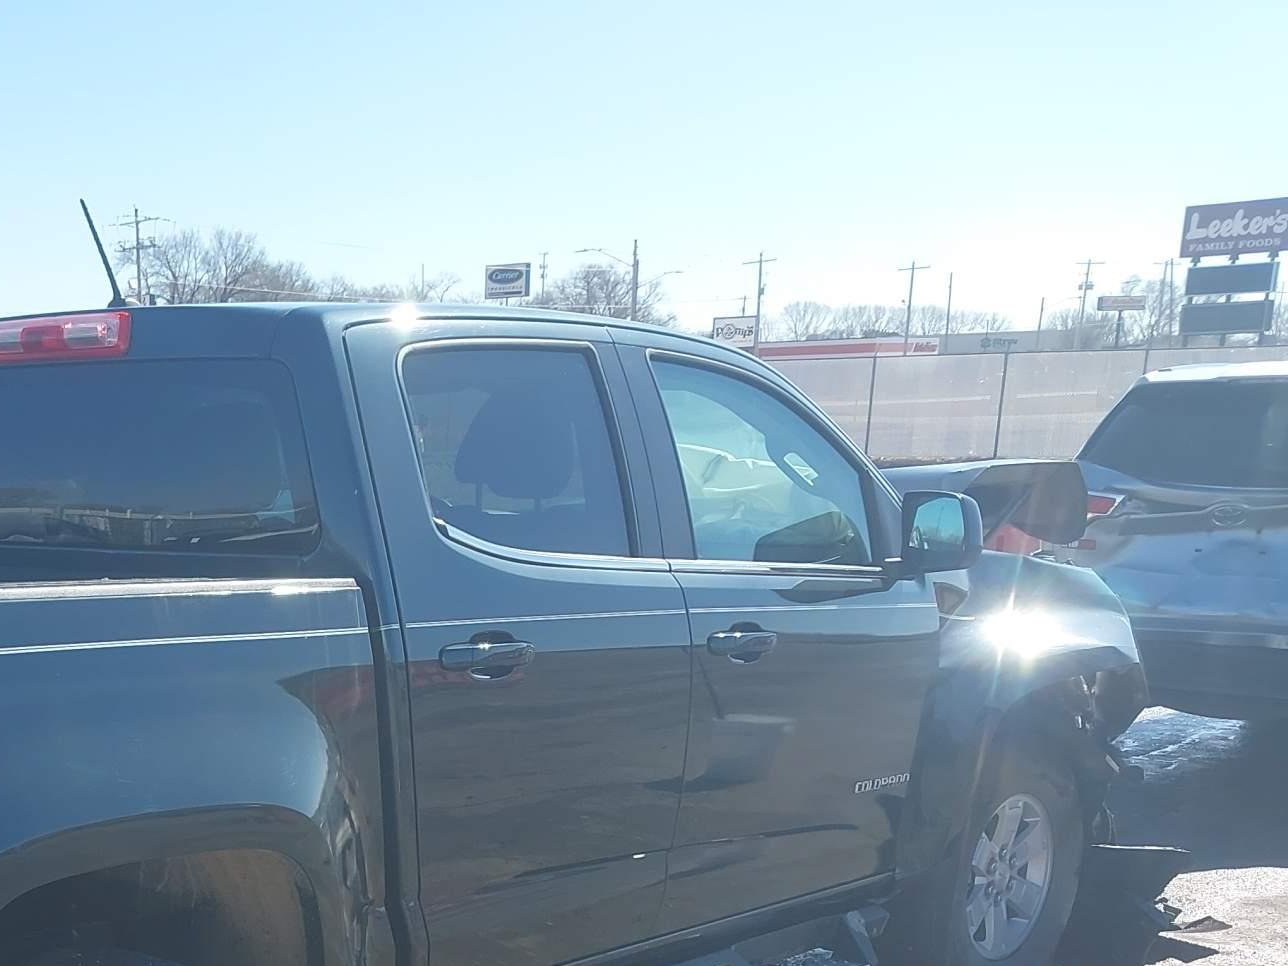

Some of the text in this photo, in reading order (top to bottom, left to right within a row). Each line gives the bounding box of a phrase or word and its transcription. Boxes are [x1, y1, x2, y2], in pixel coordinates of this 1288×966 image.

[1185, 208, 1288, 240] Leeker's
[1188, 238, 1281, 252] FAMILY FOODS
[855, 773, 911, 793] COLORADO
